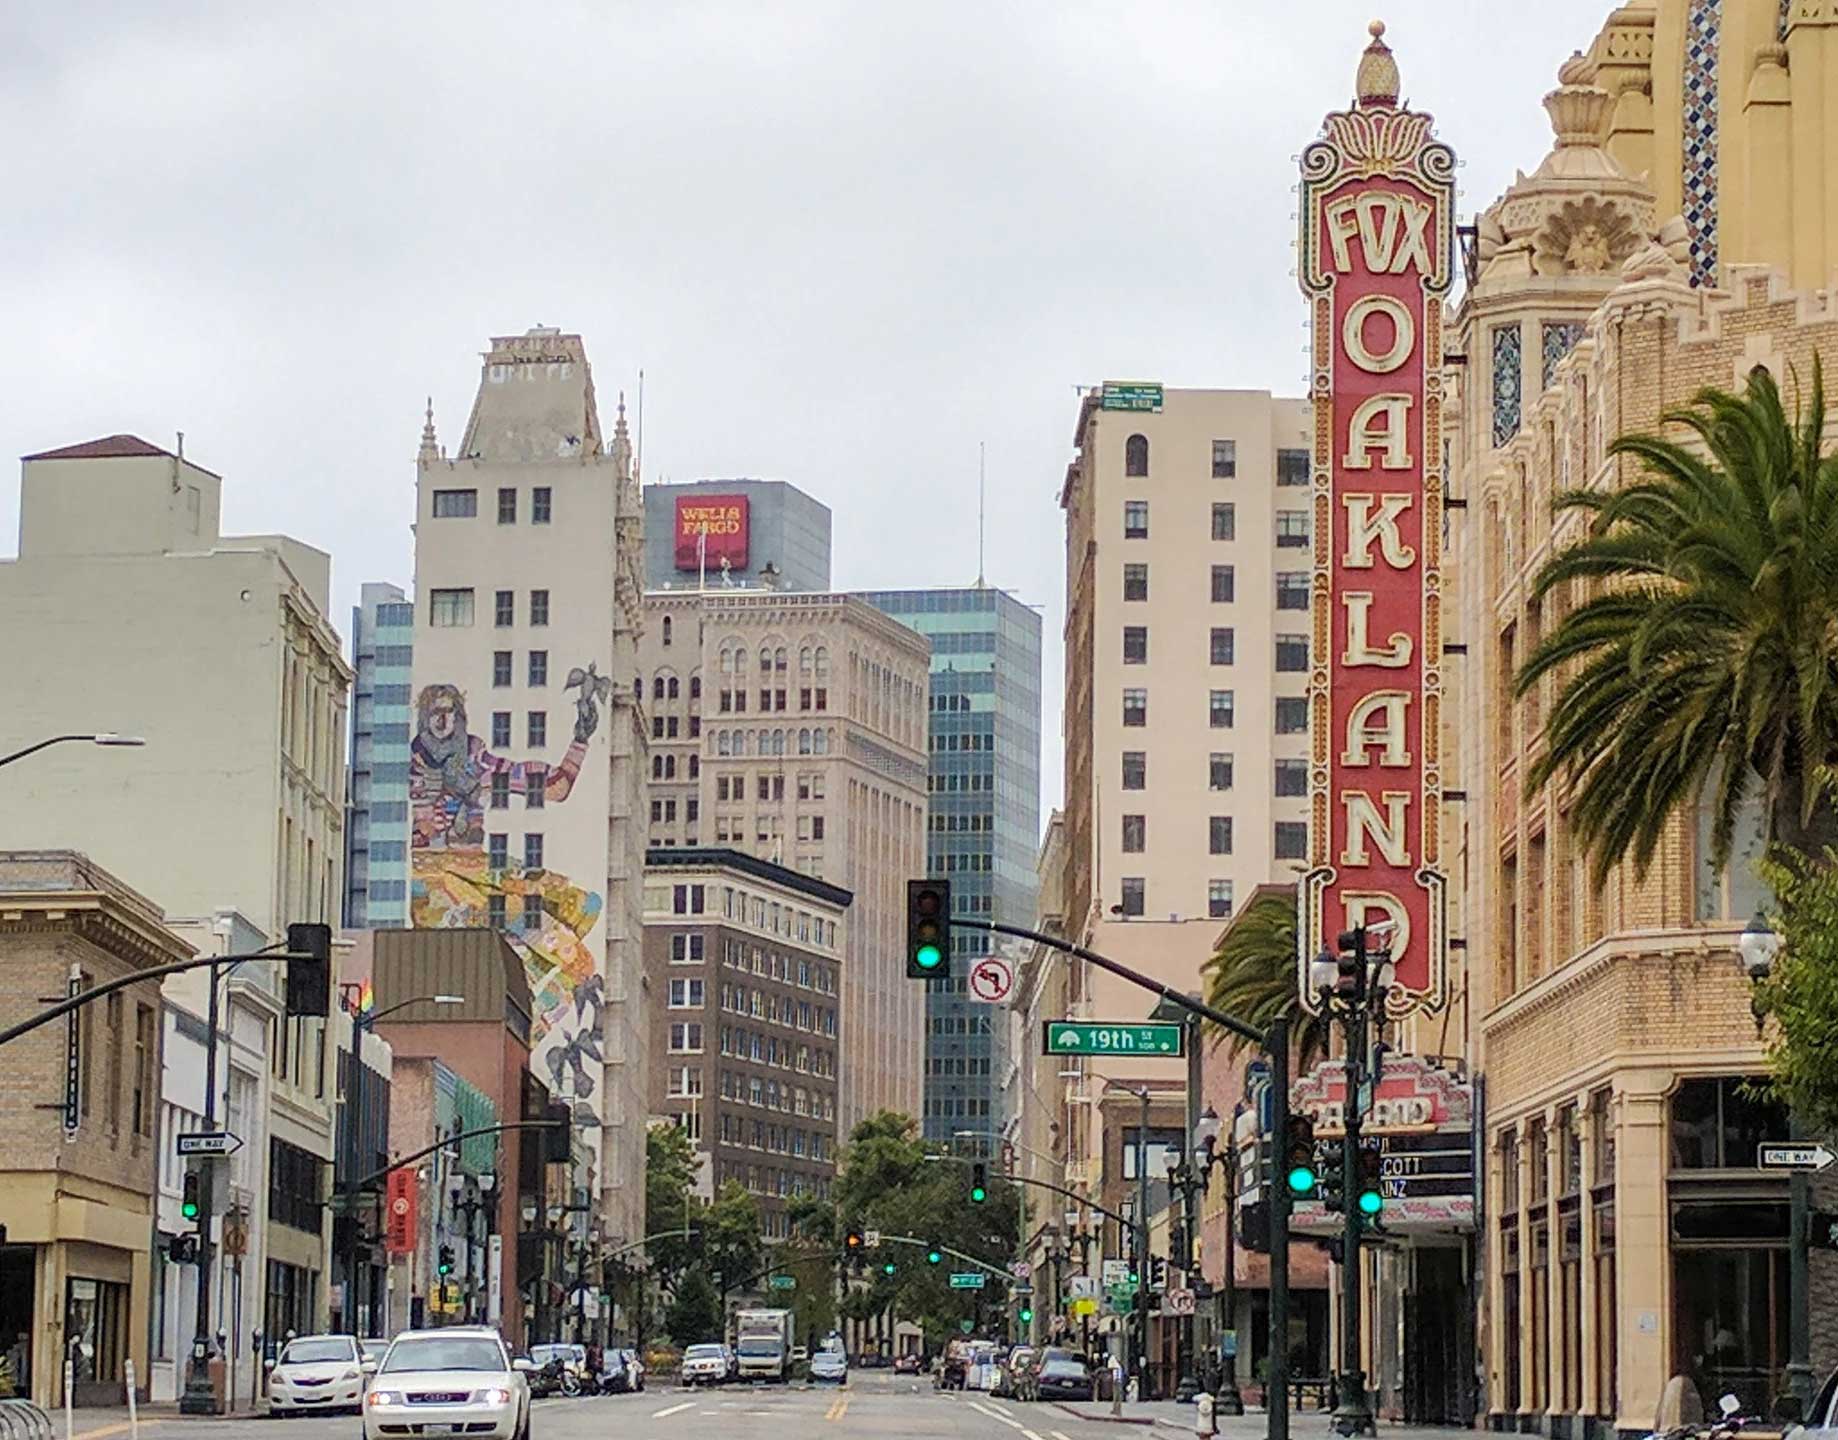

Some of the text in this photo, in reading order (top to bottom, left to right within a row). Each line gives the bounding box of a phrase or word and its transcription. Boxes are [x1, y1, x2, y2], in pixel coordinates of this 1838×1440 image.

[1324, 189, 1433, 275] FOX
[680, 506, 740, 520] WELLS
[681, 520, 740, 535] FARGO
[1340, 293, 1417, 966] OAKLAND
[1089, 1029, 1134, 1049] 19th
[183, 1139, 225, 1149] ONE WAY
[1767, 1151, 1815, 1162] ONE WAY
